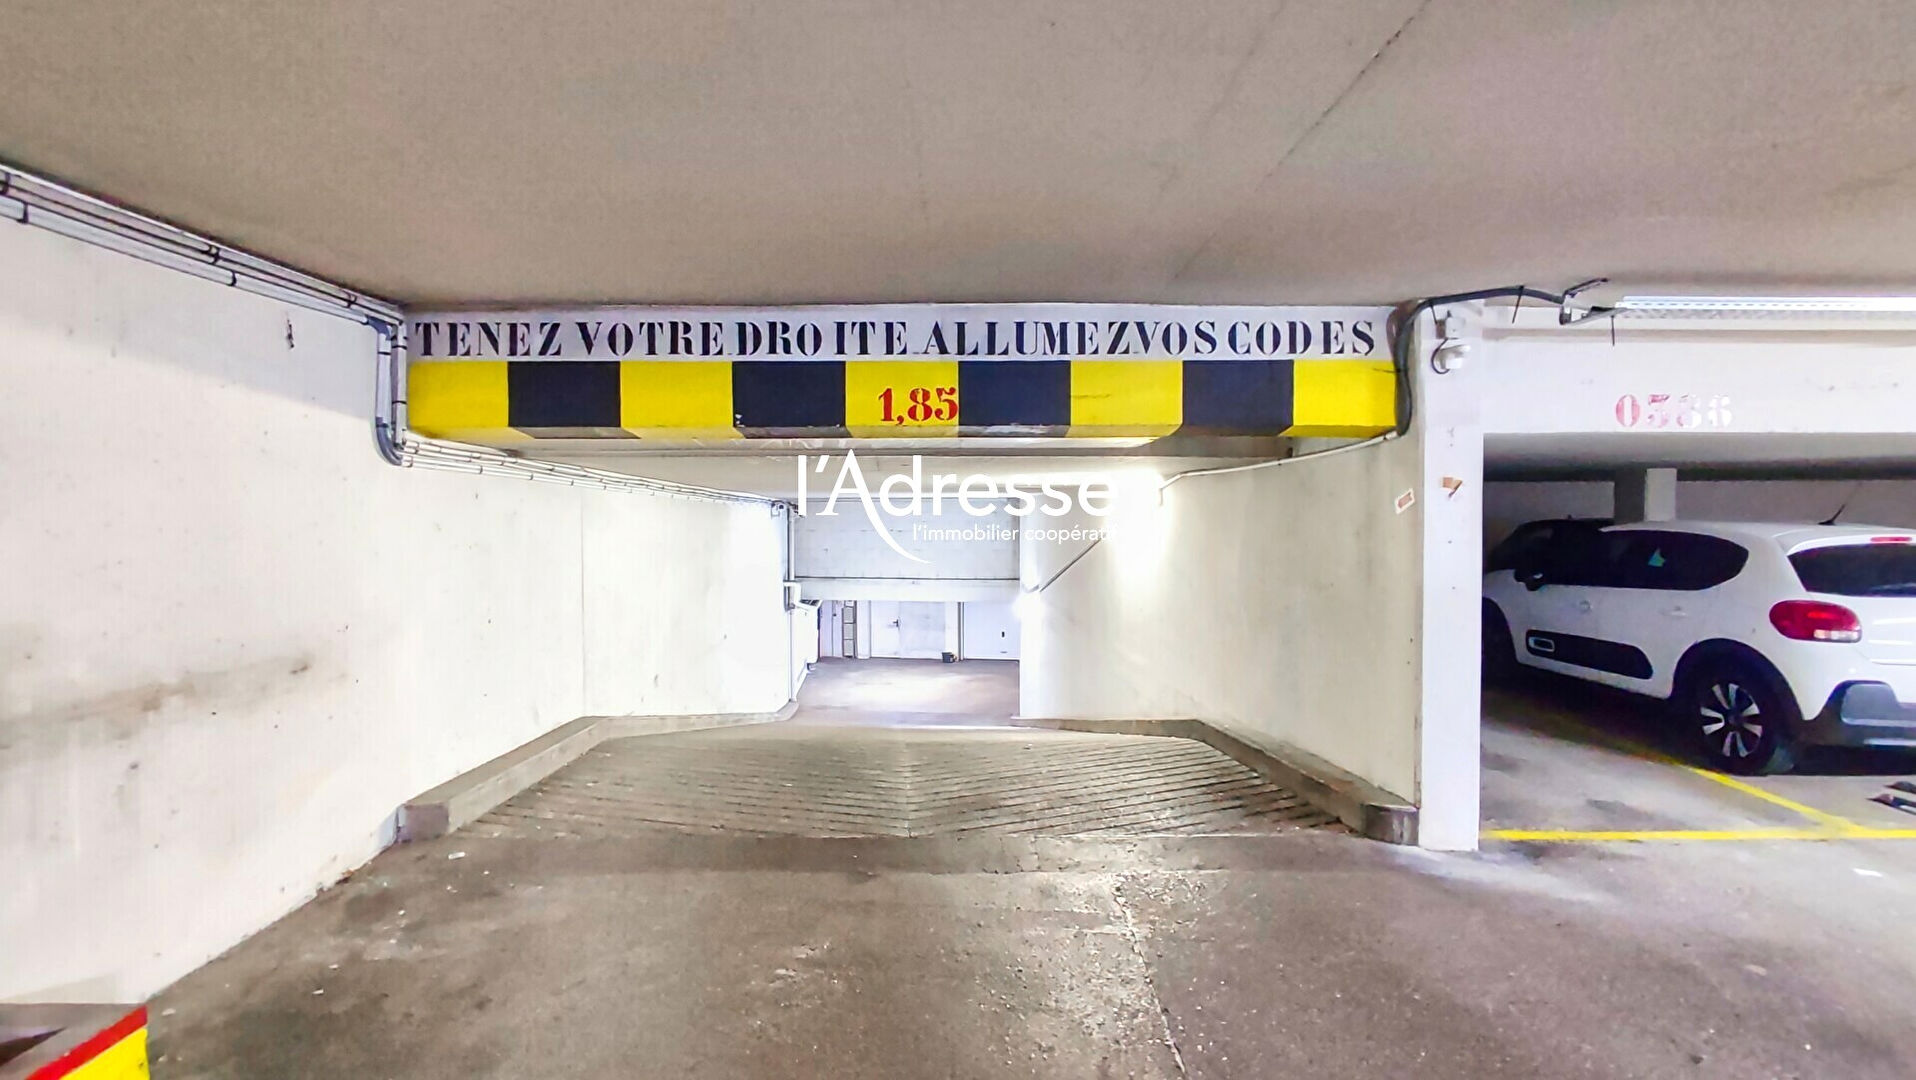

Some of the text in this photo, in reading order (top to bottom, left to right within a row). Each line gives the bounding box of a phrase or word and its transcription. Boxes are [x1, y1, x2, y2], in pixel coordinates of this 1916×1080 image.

[415, 321, 561, 357] TENEZ
[574, 321, 724, 357] VOTRE
[1228, 321, 1375, 357] CODES
[878, 387, 958, 426] 1,85
